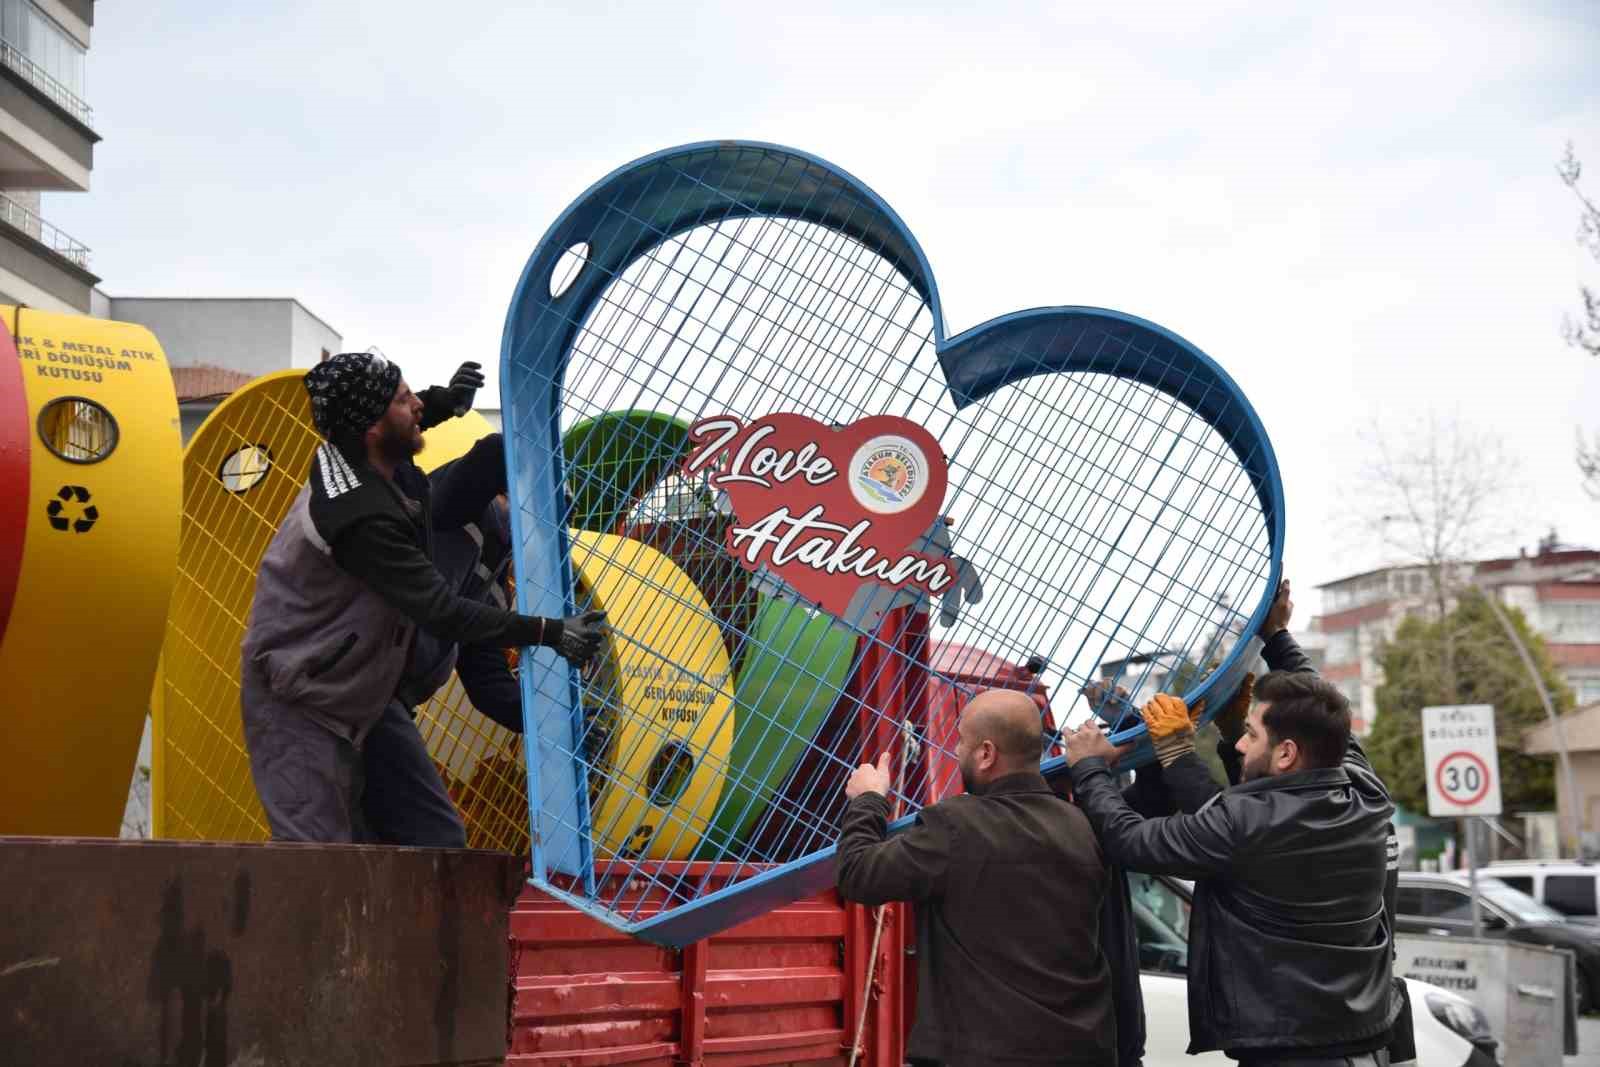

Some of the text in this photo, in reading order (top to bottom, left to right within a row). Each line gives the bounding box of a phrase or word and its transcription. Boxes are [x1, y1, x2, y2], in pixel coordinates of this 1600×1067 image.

[63, 342, 115, 355] METAL
[121, 349, 155, 360] ATIK
[37, 365, 103, 383] KUTUSU
[716, 425, 837, 487] Love
[732, 505, 952, 591] Atakum
[1446, 765, 1480, 791] 30
[1413, 956, 1467, 971] ATAKUM
